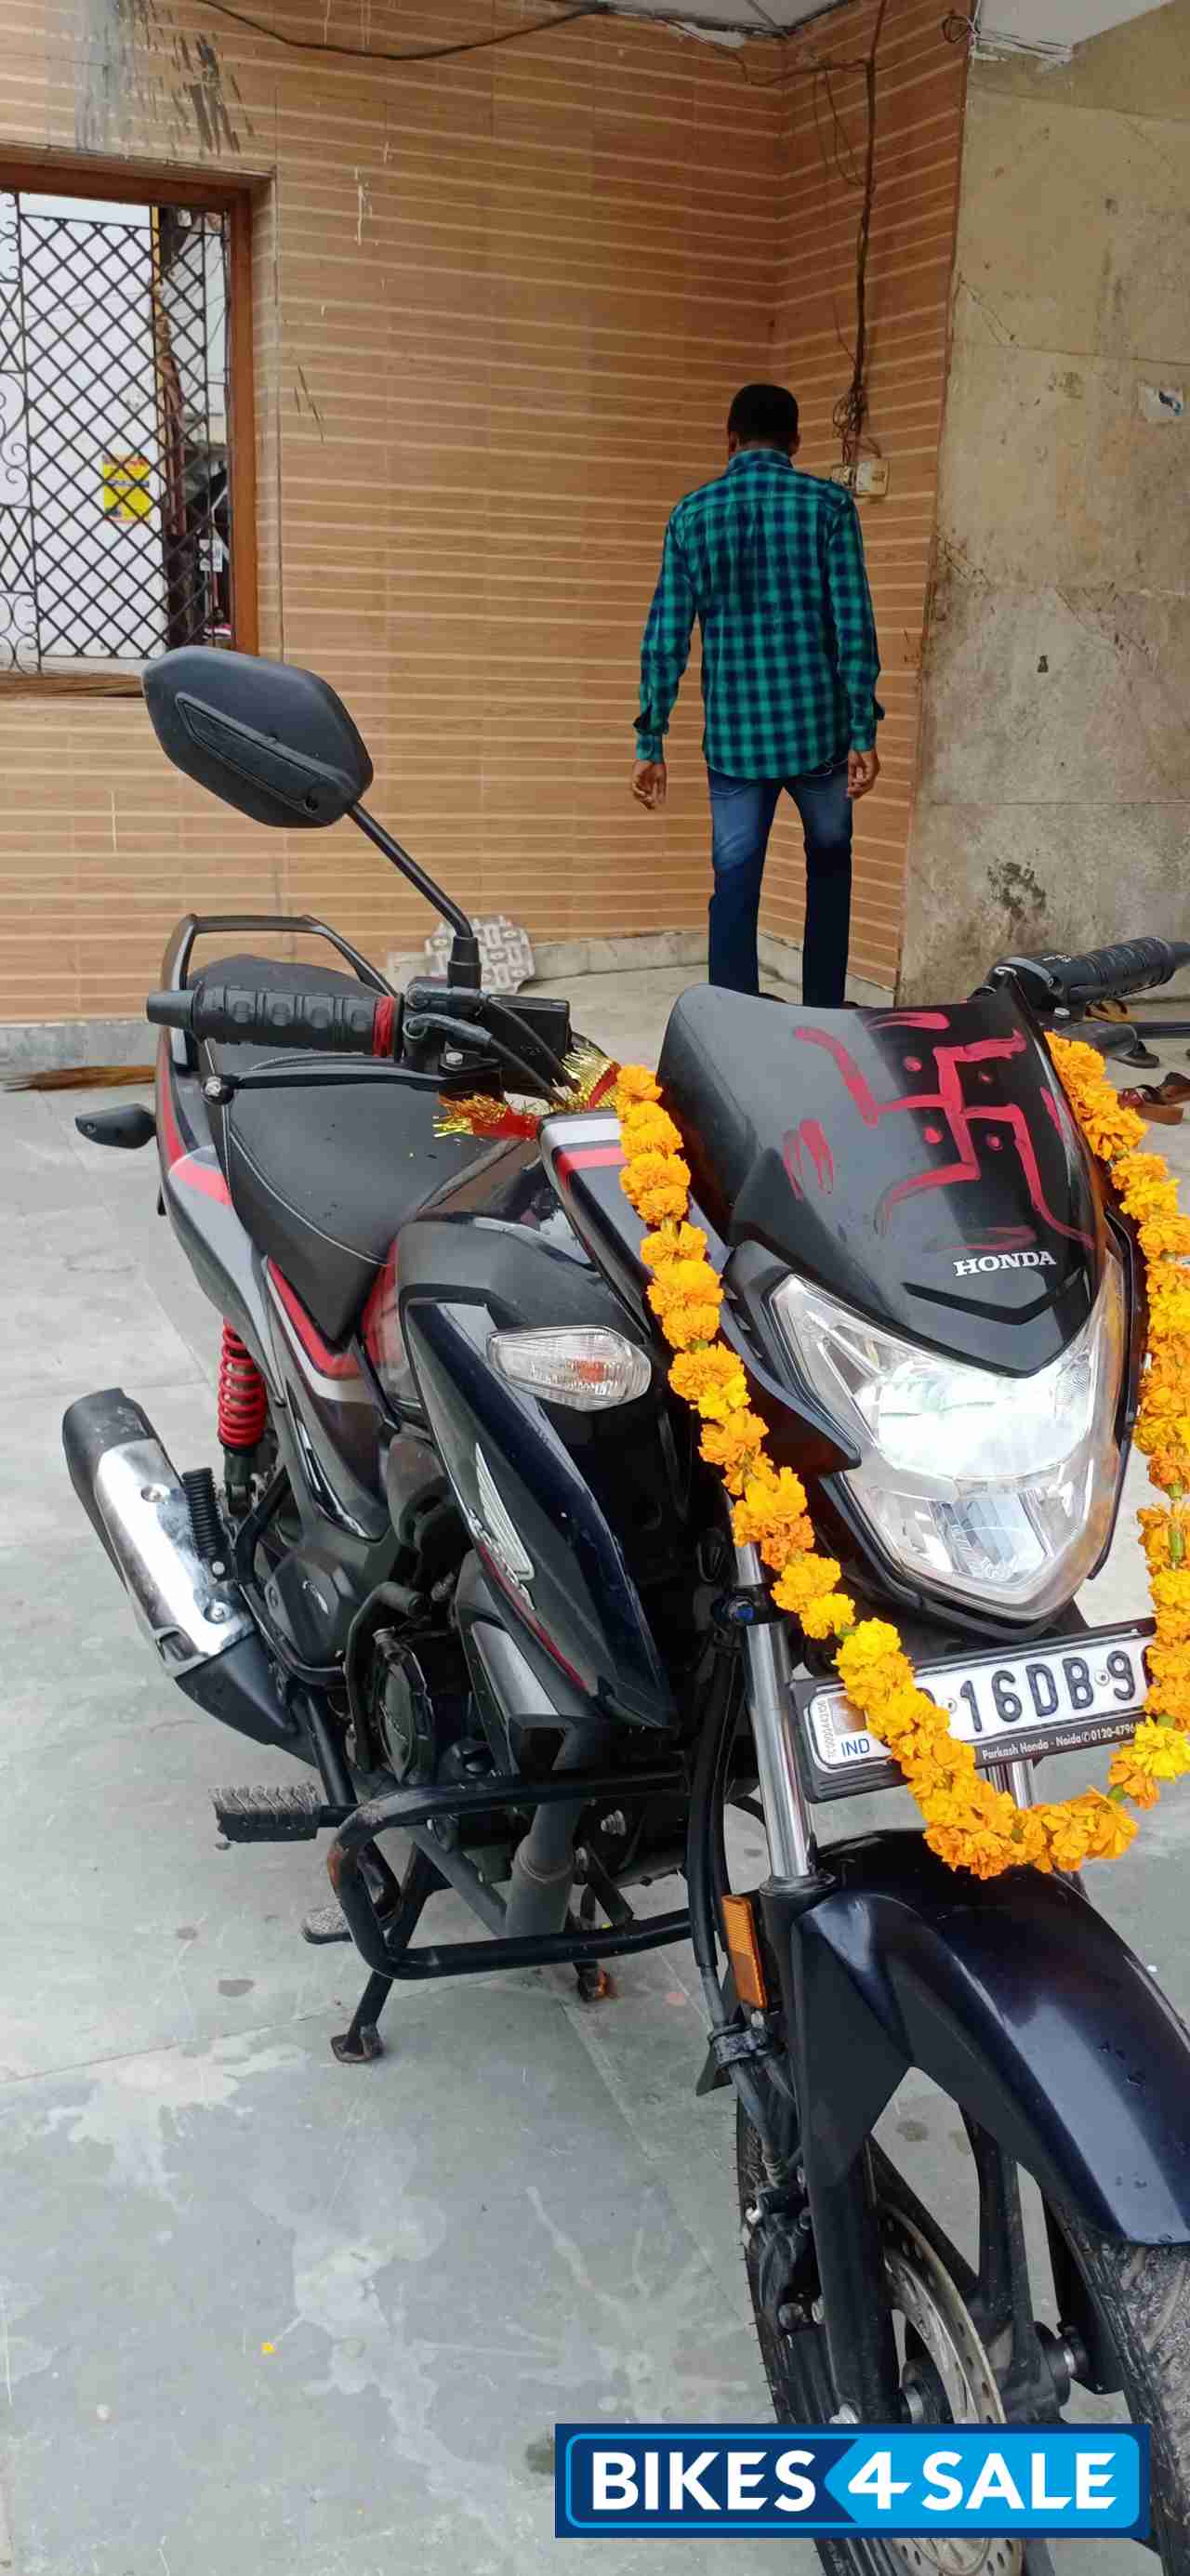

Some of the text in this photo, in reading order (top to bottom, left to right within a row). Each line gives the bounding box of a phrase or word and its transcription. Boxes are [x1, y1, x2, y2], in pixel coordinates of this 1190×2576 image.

[953, 1251, 1056, 1276] HONDA
[840, 1737, 870, 1756] IND
[1020, 1738, 1050, 1754] Honda
[1091, 1723, 1136, 1741] 0120-4796
